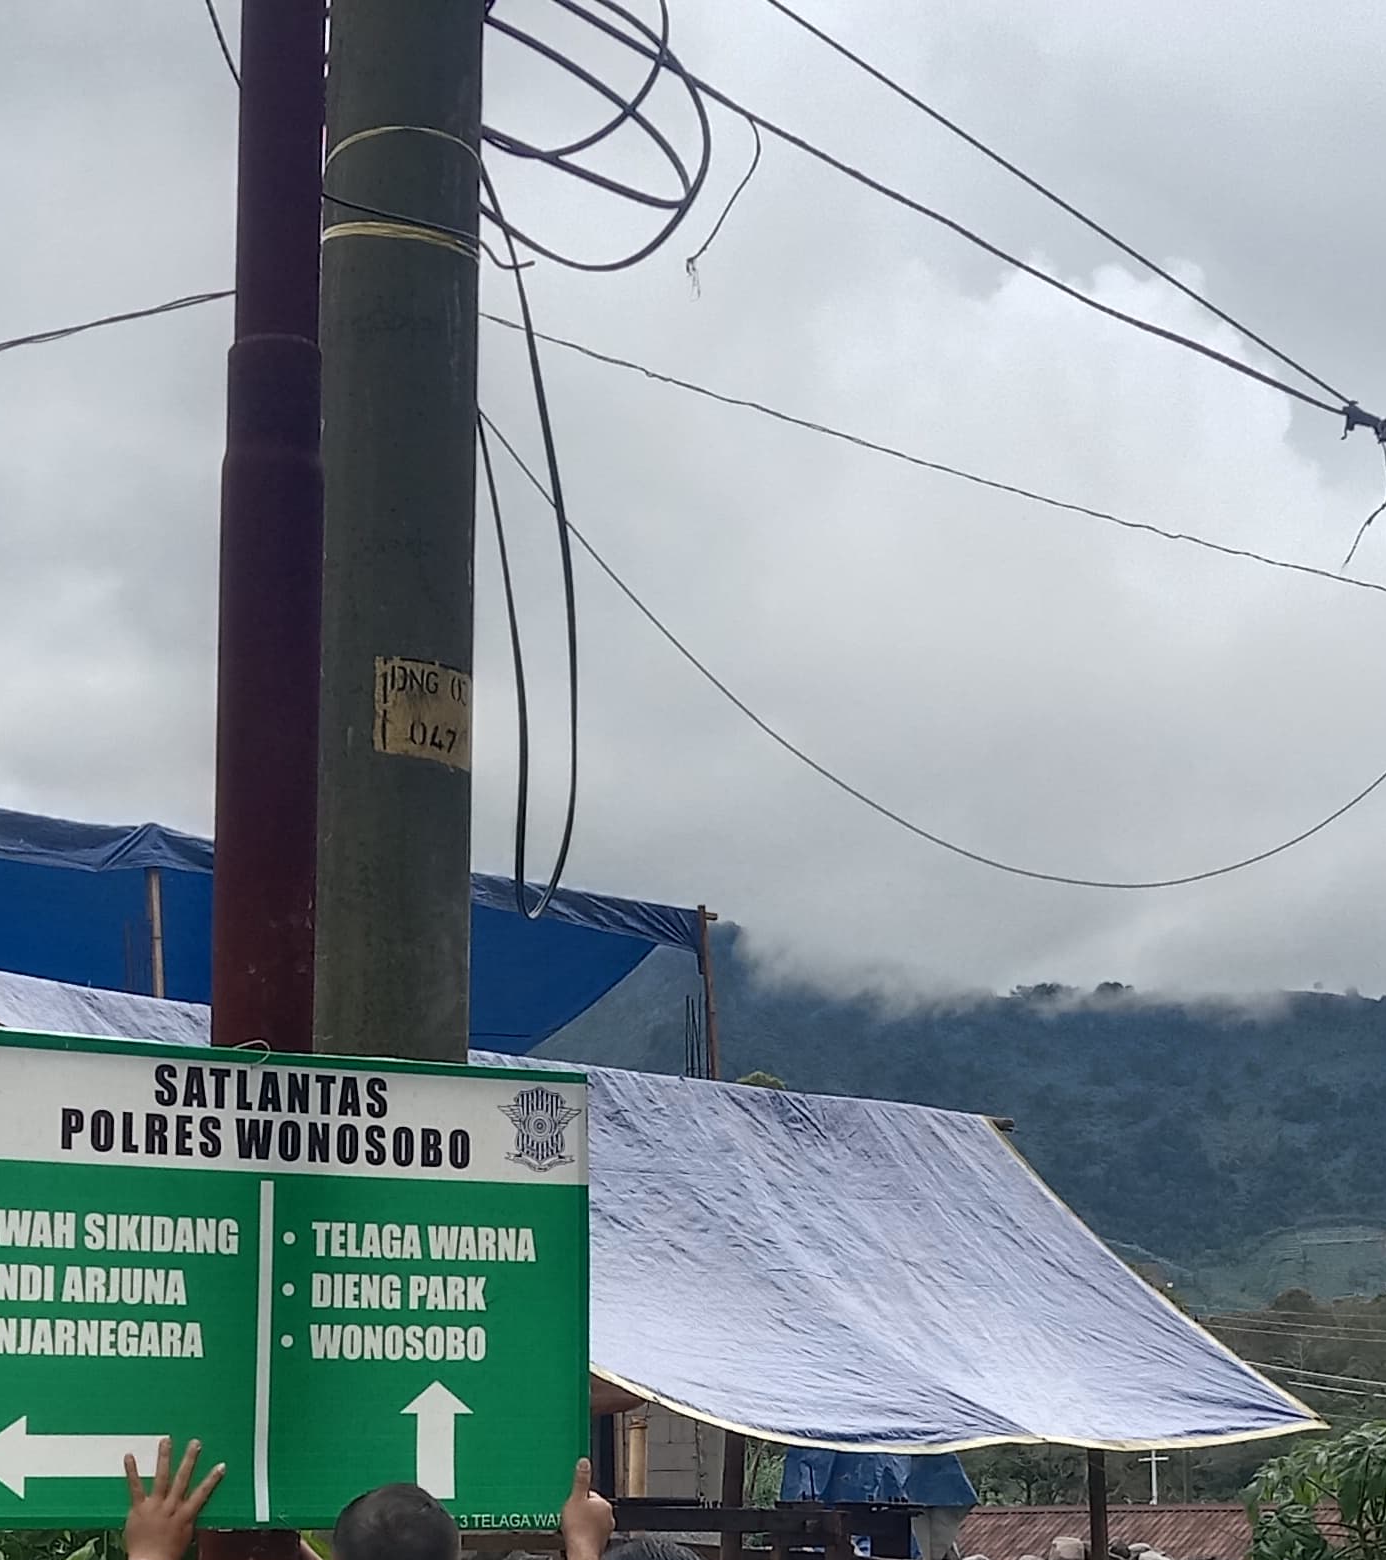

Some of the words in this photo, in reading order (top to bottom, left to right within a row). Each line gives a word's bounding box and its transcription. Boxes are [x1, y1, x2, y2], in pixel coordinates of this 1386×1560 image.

[409, 721, 457, 753] 047
[154, 1063, 389, 1119] SATLANTAS
[60, 1107, 223, 1159] POLRES
[235, 1118, 471, 1170] WONOSOBO
[83, 1212, 239, 1255] SIKIDANG
[311, 1221, 423, 1260] TELAGA
[427, 1224, 537, 1262] WARNA
[61, 1265, 187, 1306] ARJUNA
[311, 1272, 402, 1310] DIENG
[408, 1275, 487, 1311] PARK
[309, 1323, 486, 1361] WONOSOBO
[459, 1514, 469, 1528] 3
[471, 1513, 531, 1528] TELAGA
